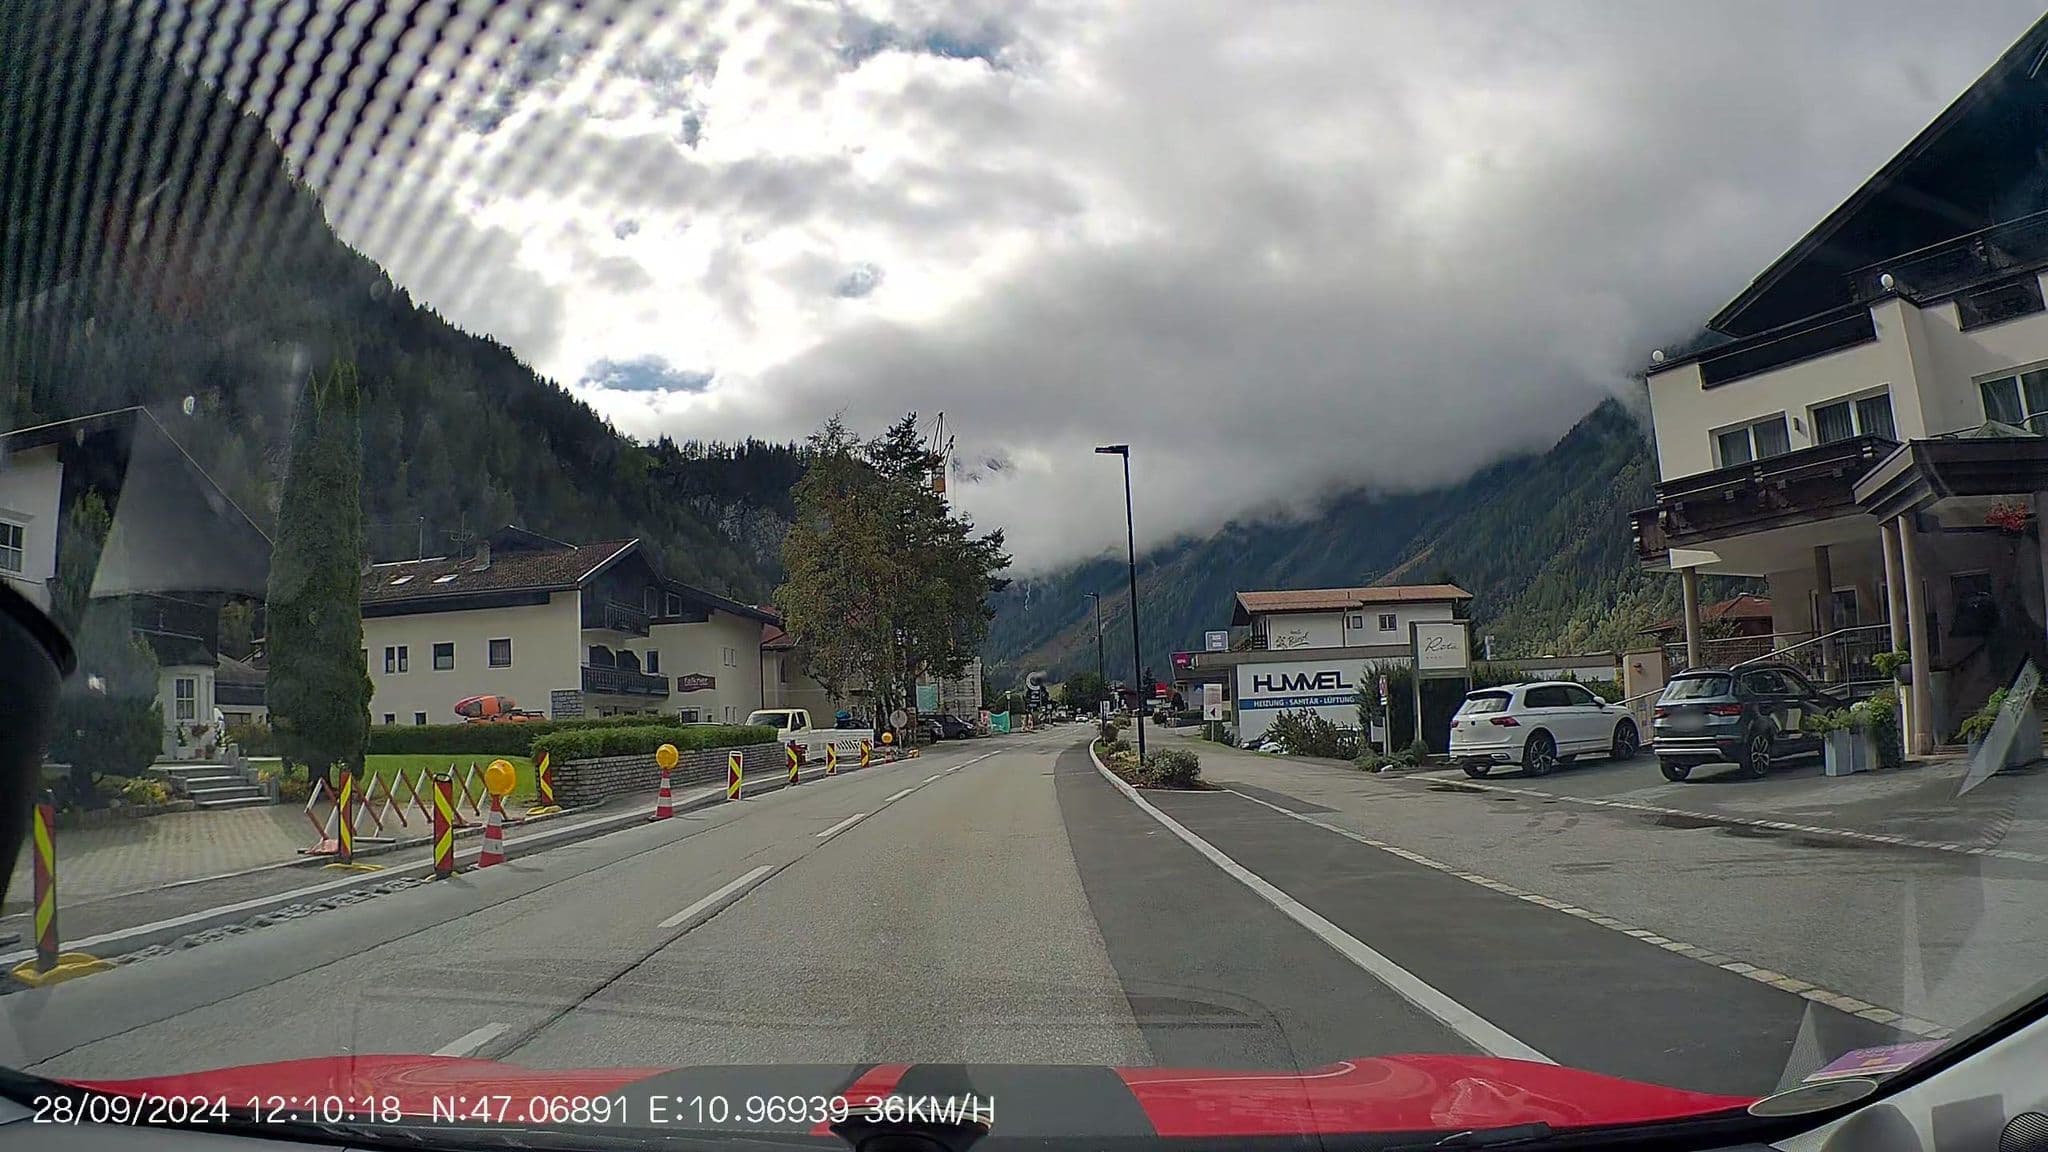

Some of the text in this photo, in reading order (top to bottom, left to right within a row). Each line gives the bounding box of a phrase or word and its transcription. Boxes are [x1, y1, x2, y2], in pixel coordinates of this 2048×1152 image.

[1253, 671, 1353, 693] HUMMEL
[1254, 695, 1355, 708] HEIZUNG SANITÄR LÜFTUNG
